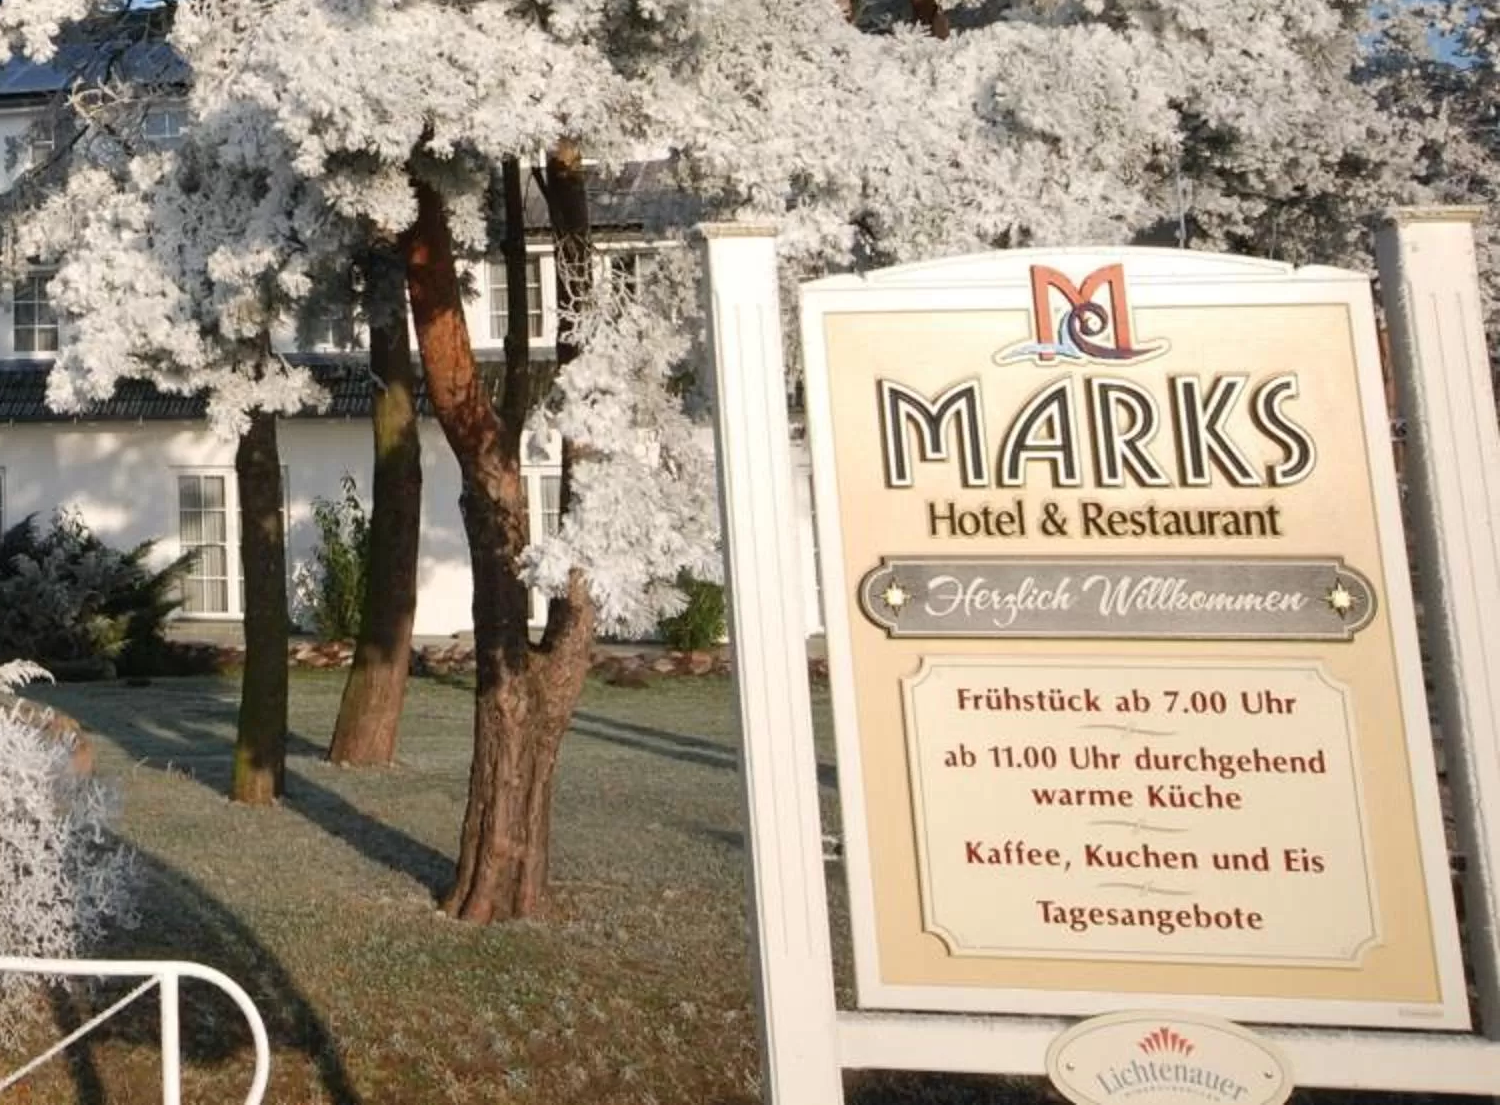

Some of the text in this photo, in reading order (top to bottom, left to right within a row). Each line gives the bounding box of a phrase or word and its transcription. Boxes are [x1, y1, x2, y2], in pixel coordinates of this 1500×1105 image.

[877, 374, 1318, 488] MARKS
[929, 502, 1282, 538] Hotel & Restaurant
[924, 574, 1306, 627] Herzlich Willkommen
[957, 687, 1298, 717] Frühstück ab 7.00 Uhr
[944, 745, 1327, 778] ab 11.00 Uhr durchgehend
[1032, 785, 1242, 811] warme Küche
[965, 841, 1326, 874] Kaffee, Kuchen und Eis
[1037, 901, 1264, 933] Tagesangebote
[1095, 1059, 1249, 1101] Lichtenauer
